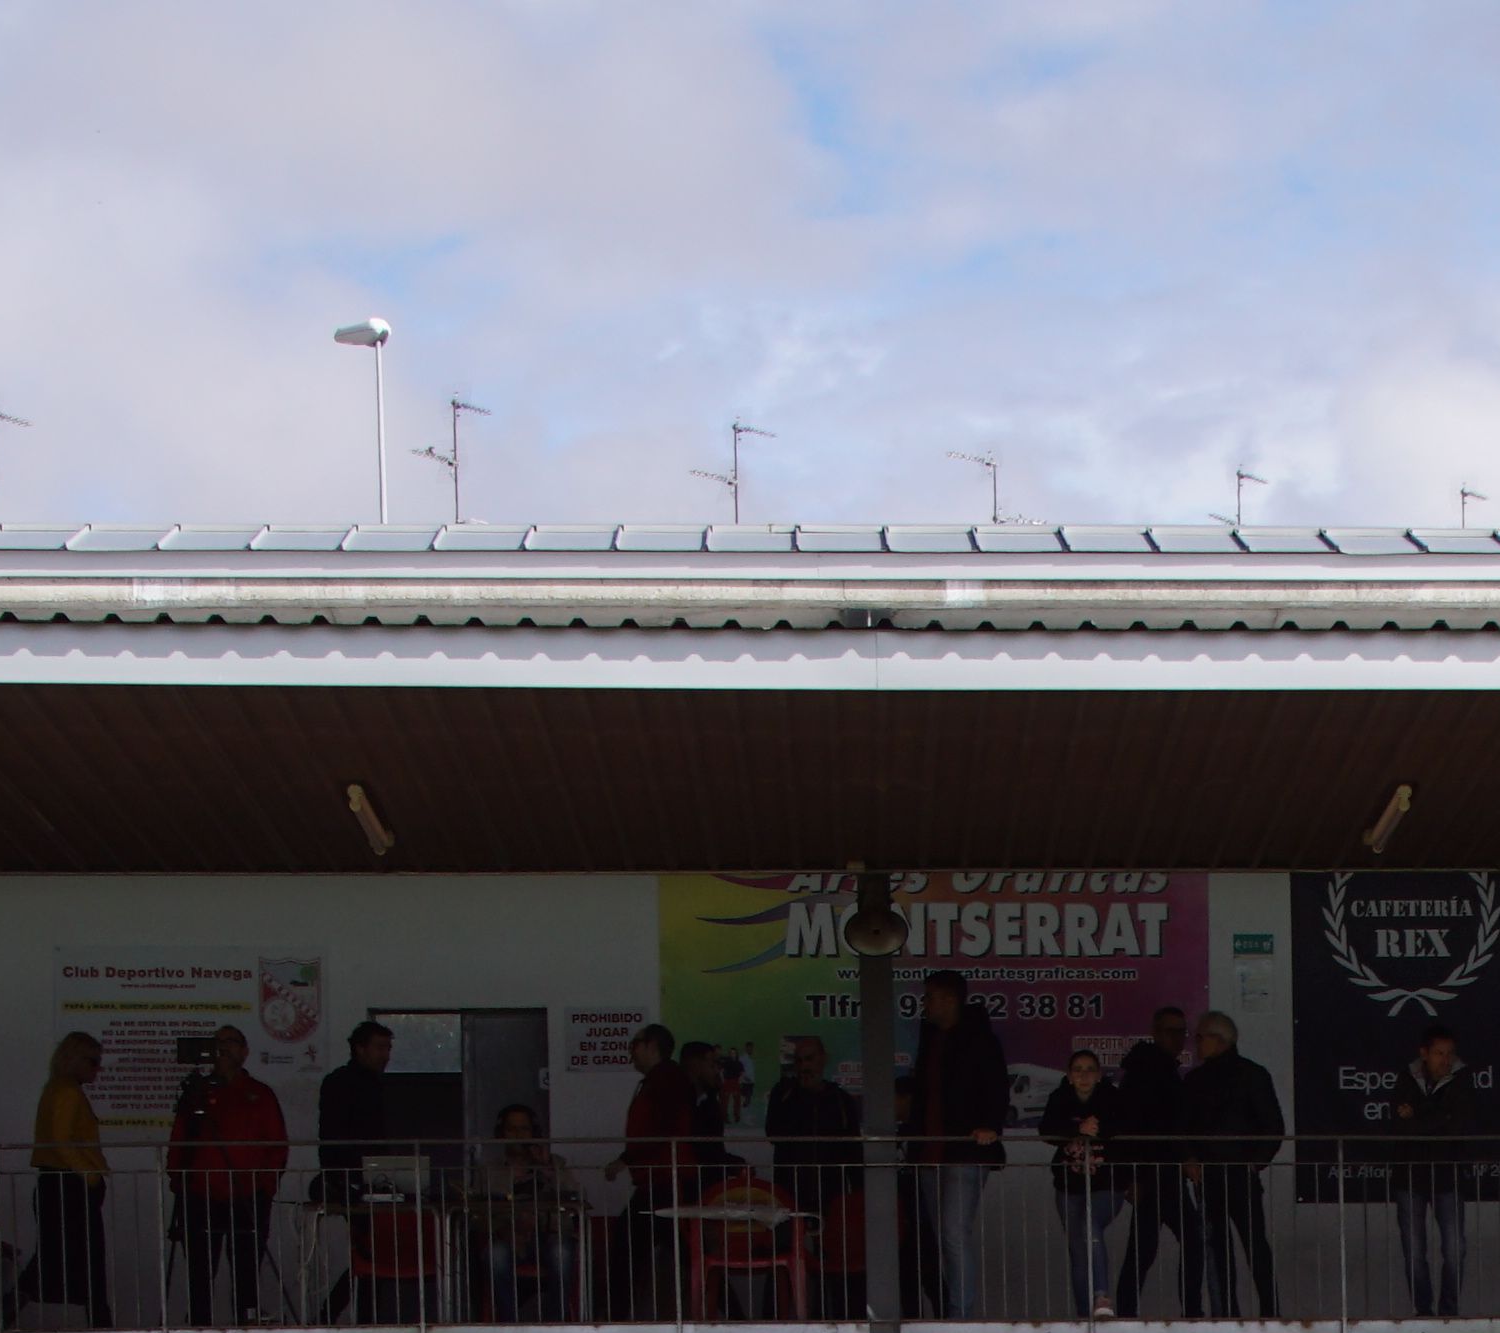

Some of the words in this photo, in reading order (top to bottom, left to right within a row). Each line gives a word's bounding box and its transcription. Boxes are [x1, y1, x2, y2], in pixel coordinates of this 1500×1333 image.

[1350, 896, 1475, 918] CAFETERÍA
[786, 901, 1169, 957] MNTSERRAT
[1374, 928, 1452, 958] REX
[62, 965, 100, 979] Club
[104, 965, 186, 981] Deportivo
[190, 965, 253, 981] Navega
[1019, 994, 1057, 1018] 38
[1066, 994, 1104, 1018] 81
[572, 1013, 643, 1023] PROHIBIDO
[586, 1027, 629, 1037] JUGAR
[580, 1042, 597, 1051] EN
[571, 1056, 589, 1065] DE
